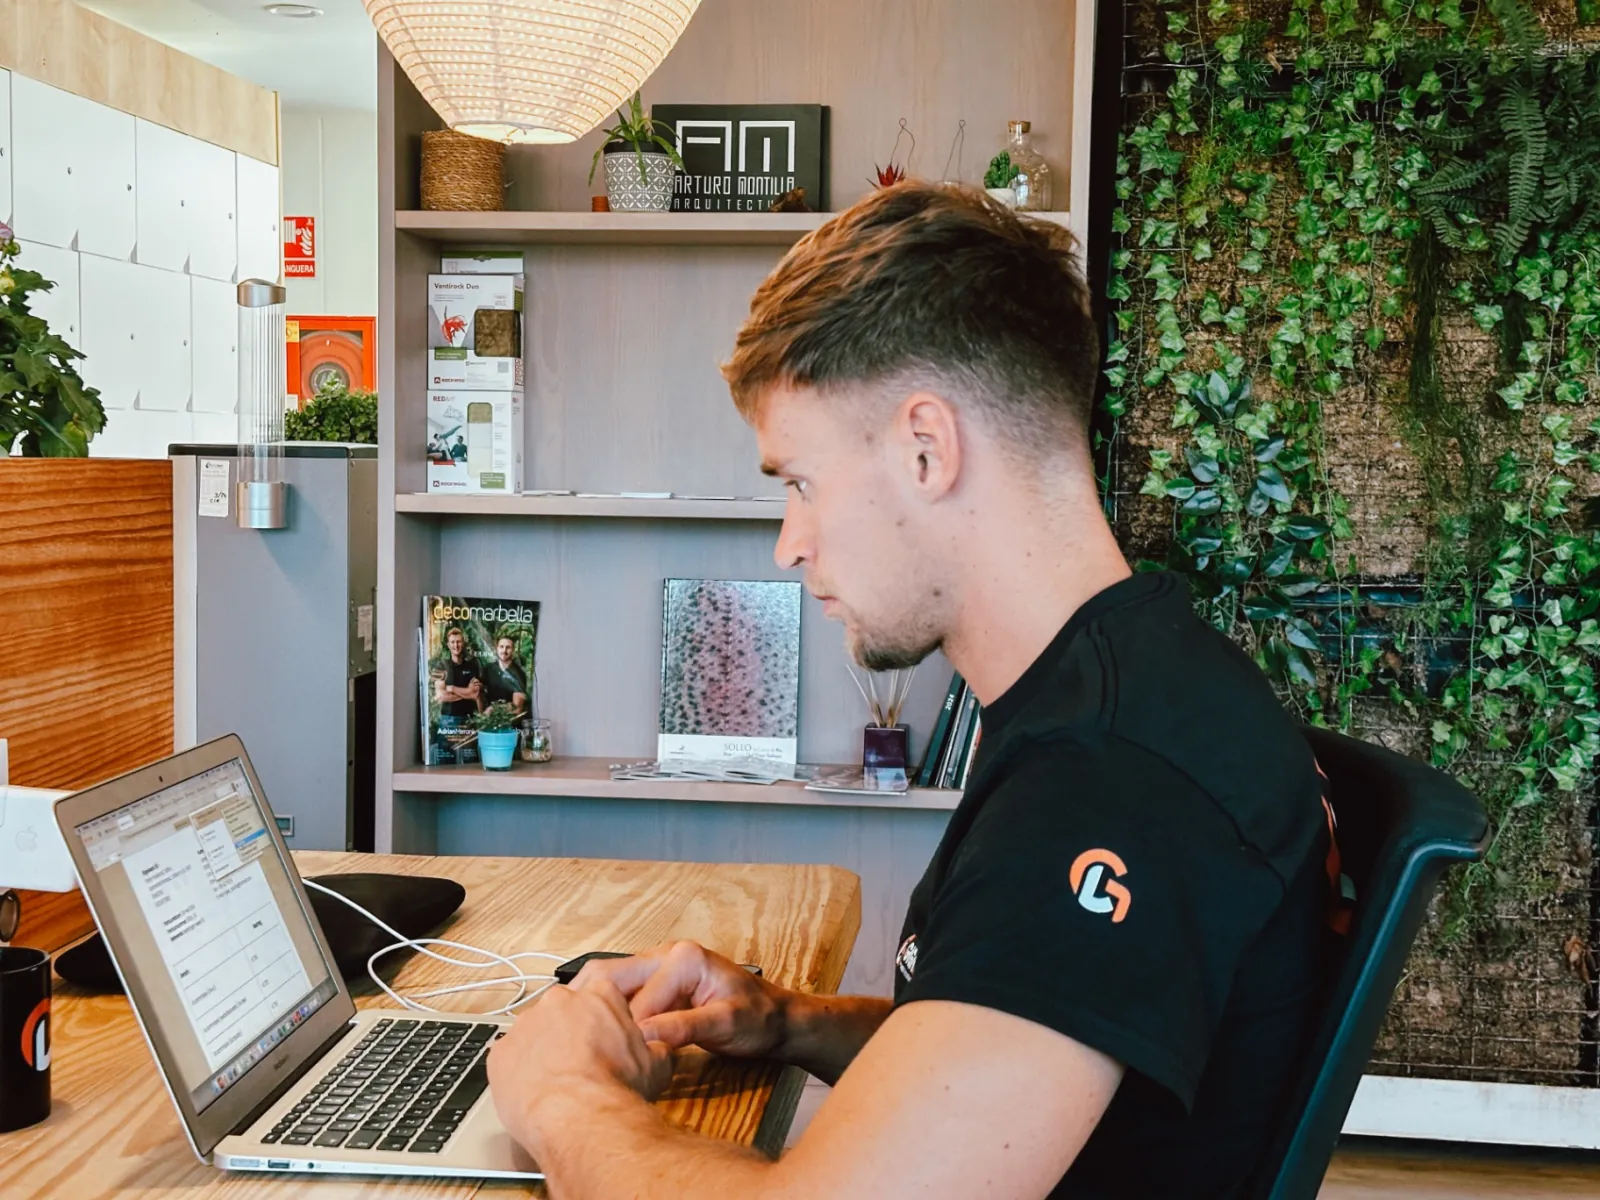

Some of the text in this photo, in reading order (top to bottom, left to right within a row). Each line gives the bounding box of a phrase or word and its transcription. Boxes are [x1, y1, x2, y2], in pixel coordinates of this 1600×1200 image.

[675, 175, 795, 196] ARTURO MONTILLA
[674, 198, 774, 211] ARQUITECTU
[433, 603, 533, 623] decomarbella
[945, 693, 956, 711] 2024
[724, 743, 752, 752] SOLLO
